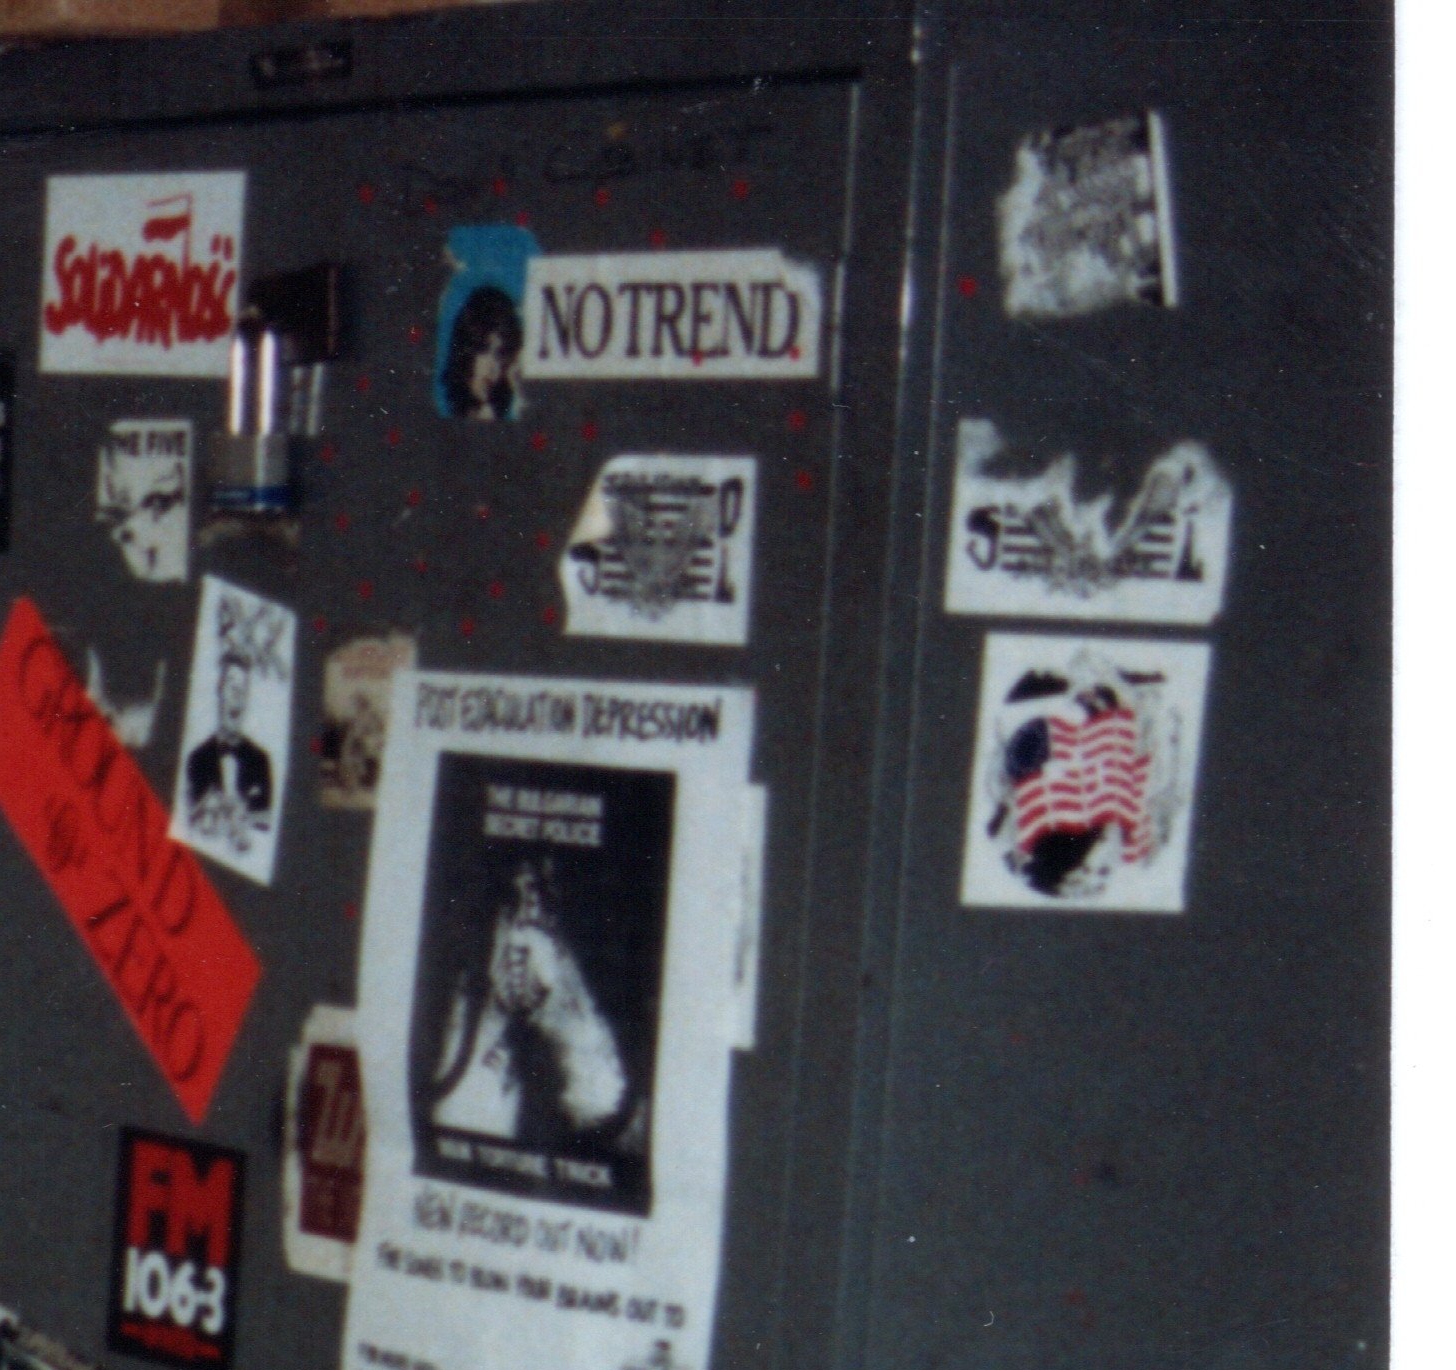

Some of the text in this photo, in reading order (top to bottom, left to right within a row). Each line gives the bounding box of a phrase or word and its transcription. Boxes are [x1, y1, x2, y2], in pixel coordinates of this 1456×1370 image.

[538, 282, 614, 360] NO
[582, 692, 724, 744] DEPRESSION
[17, 636, 198, 937] GROUND
[541, 817, 603, 847] POLICE
[85, 874, 206, 1083] ZERO
[127, 1138, 236, 1269] FM
